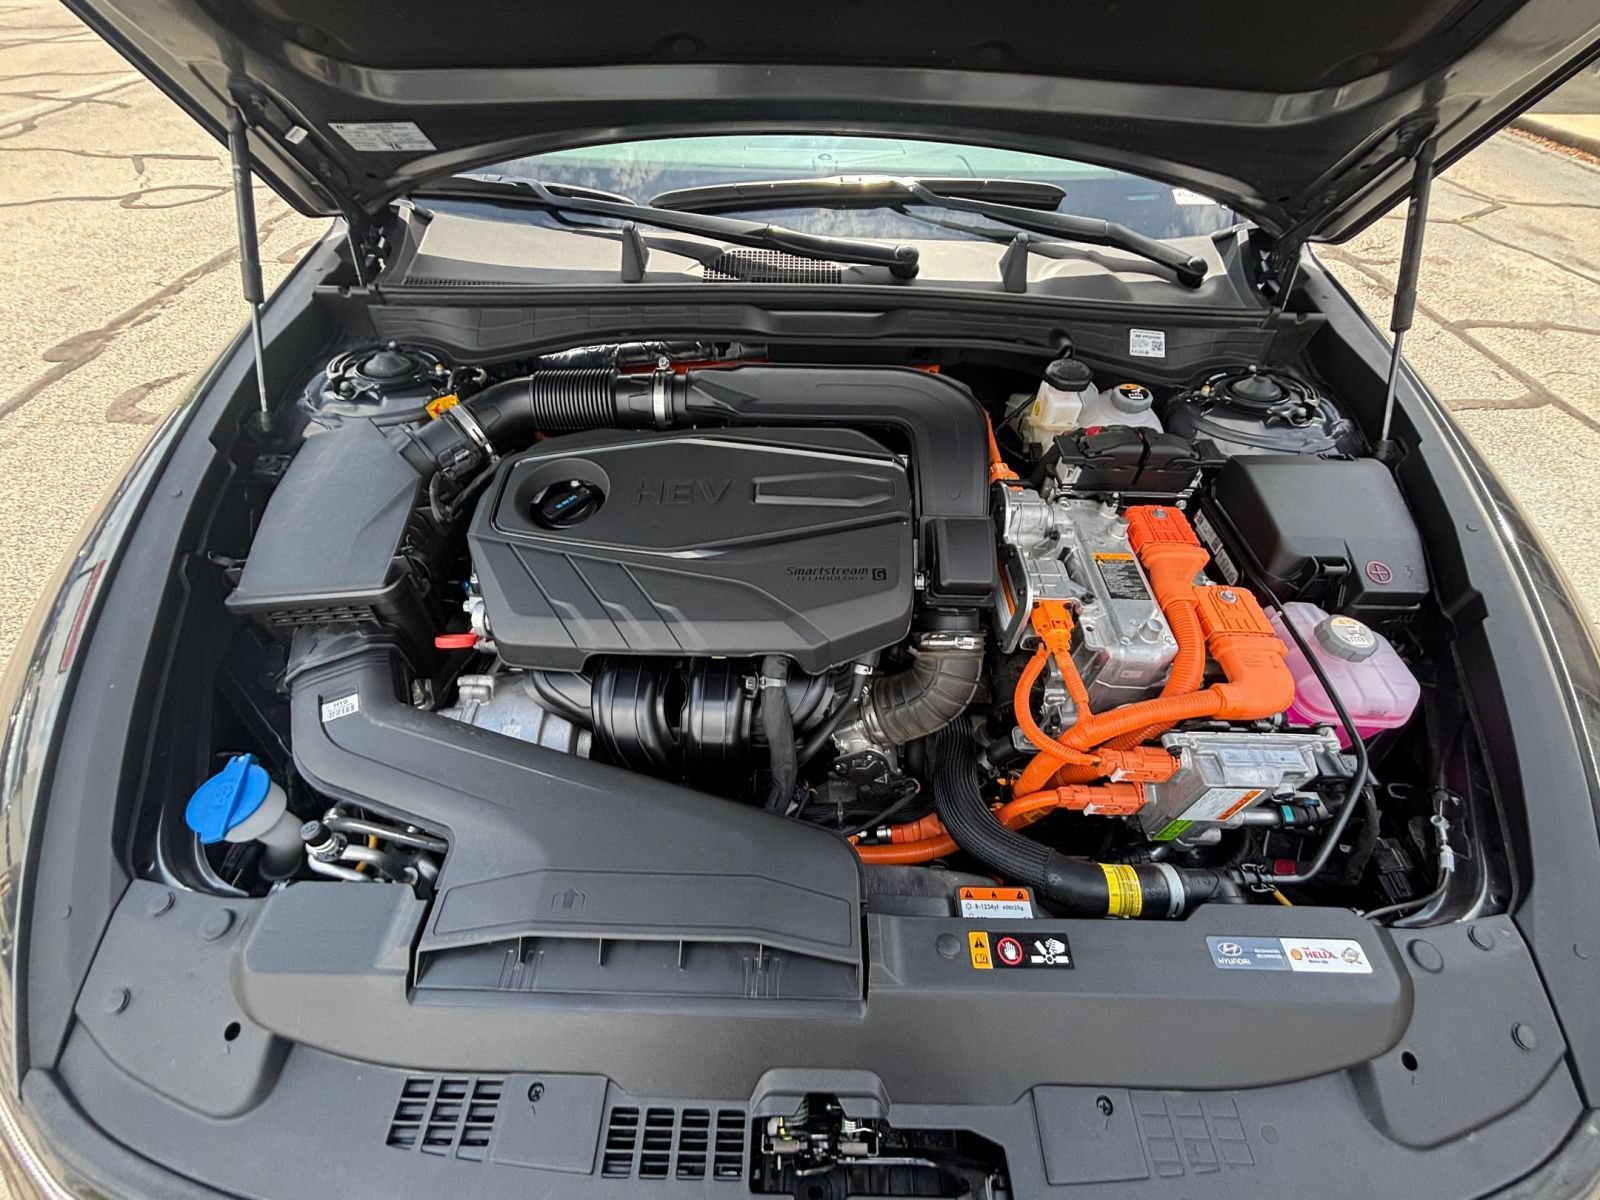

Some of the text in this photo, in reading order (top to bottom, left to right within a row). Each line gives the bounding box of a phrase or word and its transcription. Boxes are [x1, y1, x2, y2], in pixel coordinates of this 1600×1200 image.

[632, 479, 733, 505] HEV
[786, 566, 869, 576] Smartstream
[1304, 951, 1338, 960] HELIX
[1218, 957, 1251, 965] HYUNDAI
